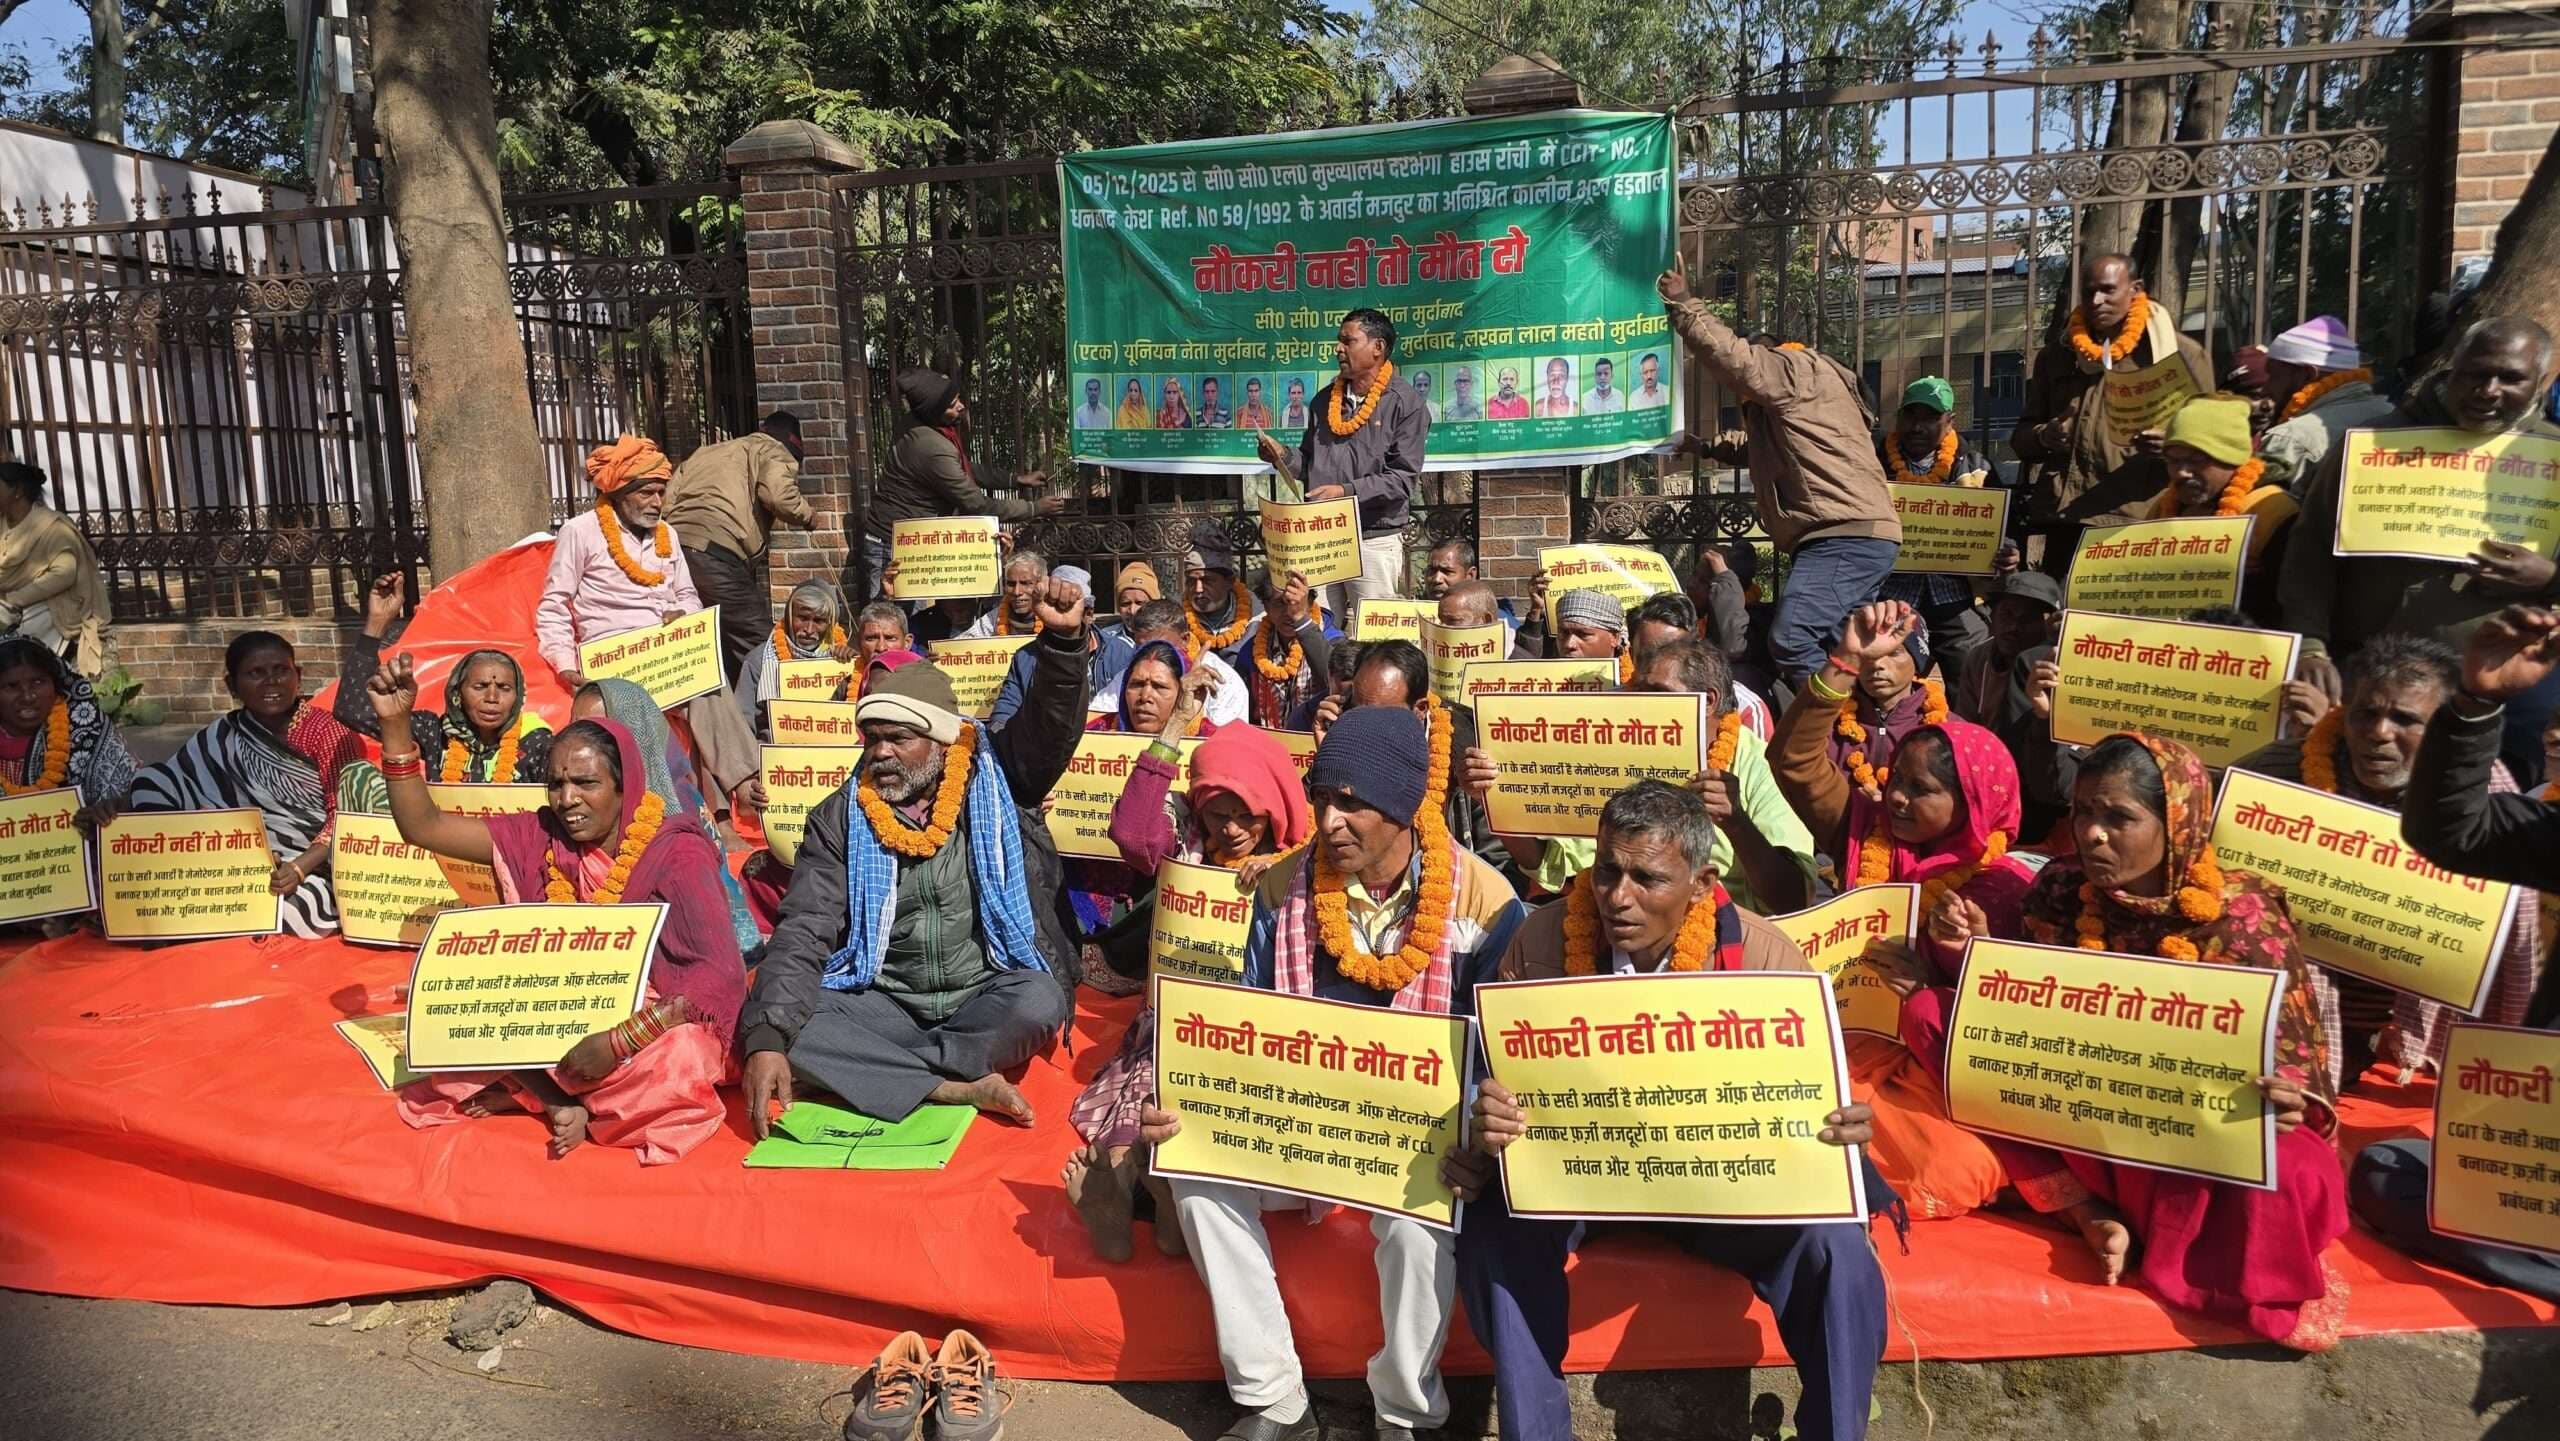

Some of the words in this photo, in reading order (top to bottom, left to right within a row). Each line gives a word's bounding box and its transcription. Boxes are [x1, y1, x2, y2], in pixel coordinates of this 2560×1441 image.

[1082, 170, 1178, 199] 05/12/2025
[1180, 166, 1197, 192] से
[1311, 159, 1384, 190] मुख्यालय
[1389, 151, 1442, 178] दरभंगा
[1450, 150, 1490, 174] हाउस
[1496, 140, 1530, 170] रांची
[1539, 138, 1558, 168] में
[1123, 204, 1152, 230] केश
[1161, 208, 1192, 228] Ref.
[1196, 209, 1218, 227] No
[1223, 200, 1291, 230] 58/1992
[1298, 194, 1314, 221] के
[1319, 190, 1363, 220] अवार्डी
[1417, 191, 1439, 213] का
[1442, 181, 1509, 211] अनिश्चित
[1512, 176, 1572, 204] कालीन
[1575, 176, 1610, 206] भूख
[1613, 168, 1670, 200] हड़ताल
[1190, 241, 1301, 294] नौकरी
[1301, 236, 1376, 290] नहीं
[1372, 234, 1415, 286] तो
[1416, 231, 1485, 283] मौत
[1487, 224, 1531, 276] दो
[1412, 301, 1464, 328] मुर्दाबाद
[1073, 340, 1119, 364] (एटक)
[1124, 339, 1177, 366] यूनियन
[1180, 339, 1210, 360] नेता
[1213, 337, 1266, 366] मुर्दाबाद
[1400, 330, 1456, 357] मुर्दाबाद
[1518, 323, 1556, 344] लाल
[1560, 318, 1606, 342] महतो
[1610, 314, 1670, 344] मुर्दाबाद
[2360, 447, 2425, 468] नौकरी
[2428, 448, 2472, 470] नहीं
[2472, 452, 2496, 473] तो
[2499, 453, 2538, 478] मौत
[1293, 517, 1306, 532] तो
[1308, 515, 1332, 532] मौत
[1335, 513, 1347, 529] दो
[1909, 496, 1937, 516] नहीं
[1936, 497, 1951, 516] तो
[1952, 499, 1979, 519] मौत
[1980, 502, 1995, 520] दो
[922, 531, 942, 544] नहीं
[942, 531, 954, 544] तो
[955, 531, 976, 544] मौत
[978, 530, 988, 543] दो
[2085, 540, 2130, 560] नौकरी
[2130, 537, 2163, 557] नहीं
[2161, 537, 2179, 556] तो
[2180, 536, 2213, 555] मौत
[2215, 534, 2232, 554] दो
[1548, 560, 1587, 577] नौकरी
[1630, 559, 1651, 572] मौत
[1365, 610, 1398, 627] नौकरी
[588, 646, 625, 670] नौकरी
[627, 636, 651, 655] नहीं
[652, 633, 666, 647] तो
[668, 627, 692, 642] मौत
[694, 621, 706, 634] दो
[940, 652, 973, 667] नौकरी
[975, 651, 997, 665] नहीं
[996, 650, 1008, 664] तो
[1437, 643, 1450, 658] तो
[1453, 641, 1479, 659] मौत
[1482, 639, 1495, 655] दो
[2073, 634, 2134, 663] नौकरी
[2137, 643, 2181, 667] नहीं
[2178, 646, 2201, 672] तो
[2204, 650, 2245, 678] मौत
[2248, 654, 2271, 680] दो
[786, 673, 822, 690] नौकरी
[777, 714, 814, 733] नौकरी
[816, 717, 840, 734] नहीं
[840, 718, 853, 734] तो
[1488, 716, 1548, 743] नौकरी
[1551, 718, 1592, 744] नहीं
[1592, 718, 1614, 744] तो
[1616, 718, 1659, 746] मौत
[1661, 718, 1683, 746] दो
[768, 765, 814, 788] नौकरी
[1100, 755, 1131, 776] नहीं
[18, 812, 51, 835] मौत
[54, 809, 71, 831] दो
[2234, 801, 2316, 844] नौकरी
[2317, 828, 2375, 858] नहीं
[2371, 839, 2402, 868] तो
[110, 832, 166, 855] नौकरी
[168, 831, 206, 853] नहीं
[204, 830, 222, 851] तो
[221, 829, 254, 850] मौत
[339, 833, 380, 856] नौकरी
[1161, 883, 1206, 918] नौकरी
[436, 929, 500, 957] नौकरी
[502, 927, 547, 955] नहीं
[543, 927, 567, 952] तो
[568, 927, 611, 951] मौत
[613, 926, 637, 951] दो
[1824, 918, 1862, 948] मौत
[1865, 908, 1891, 933] दो
[1977, 969, 2057, 1009] नौकरी
[2060, 982, 2119, 1017] नहीं
[2116, 987, 2147, 1022] तो
[2150, 991, 2210, 1031] मौत
[2212, 998, 2245, 1035] दो
[1499, 1015, 1591, 1060] नौकरी
[1595, 1012, 1661, 1056] नहीं
[1660, 1011, 1696, 1053] तो
[1700, 1009, 1768, 1050] मौत
[1770, 1008, 1806, 1048] दो
[1174, 1013, 1257, 1056] नौकरी
[1260, 1030, 1320, 1066] नहीं
[1317, 1035, 1348, 1072] तो
[1352, 1041, 1408, 1081] मौत
[1412, 1049, 1443, 1086] दो
[2458, 1057, 2554, 1104] नौकरी
[1169, 1071, 1195, 1086] CGIT
[1198, 1073, 1210, 1088] के
[1212, 1076, 1237, 1094] सही
[1240, 1082, 1274, 1101] अवार्डी
[1275, 1086, 1285, 1103] है
[1287, 1088, 1350, 1114] मेमोरेण्डम
[1387, 1107, 1448, 1131] सेटलमेन्ट
[2000, 1087, 2036, 1109] प्रबंधन
[2039, 1092, 2061, 1113] और
[2067, 1100, 2114, 1124] यूनियन
[2118, 1107, 2143, 1129] नेता
[2146, 1116, 2195, 1139] मुर्दाबाद
